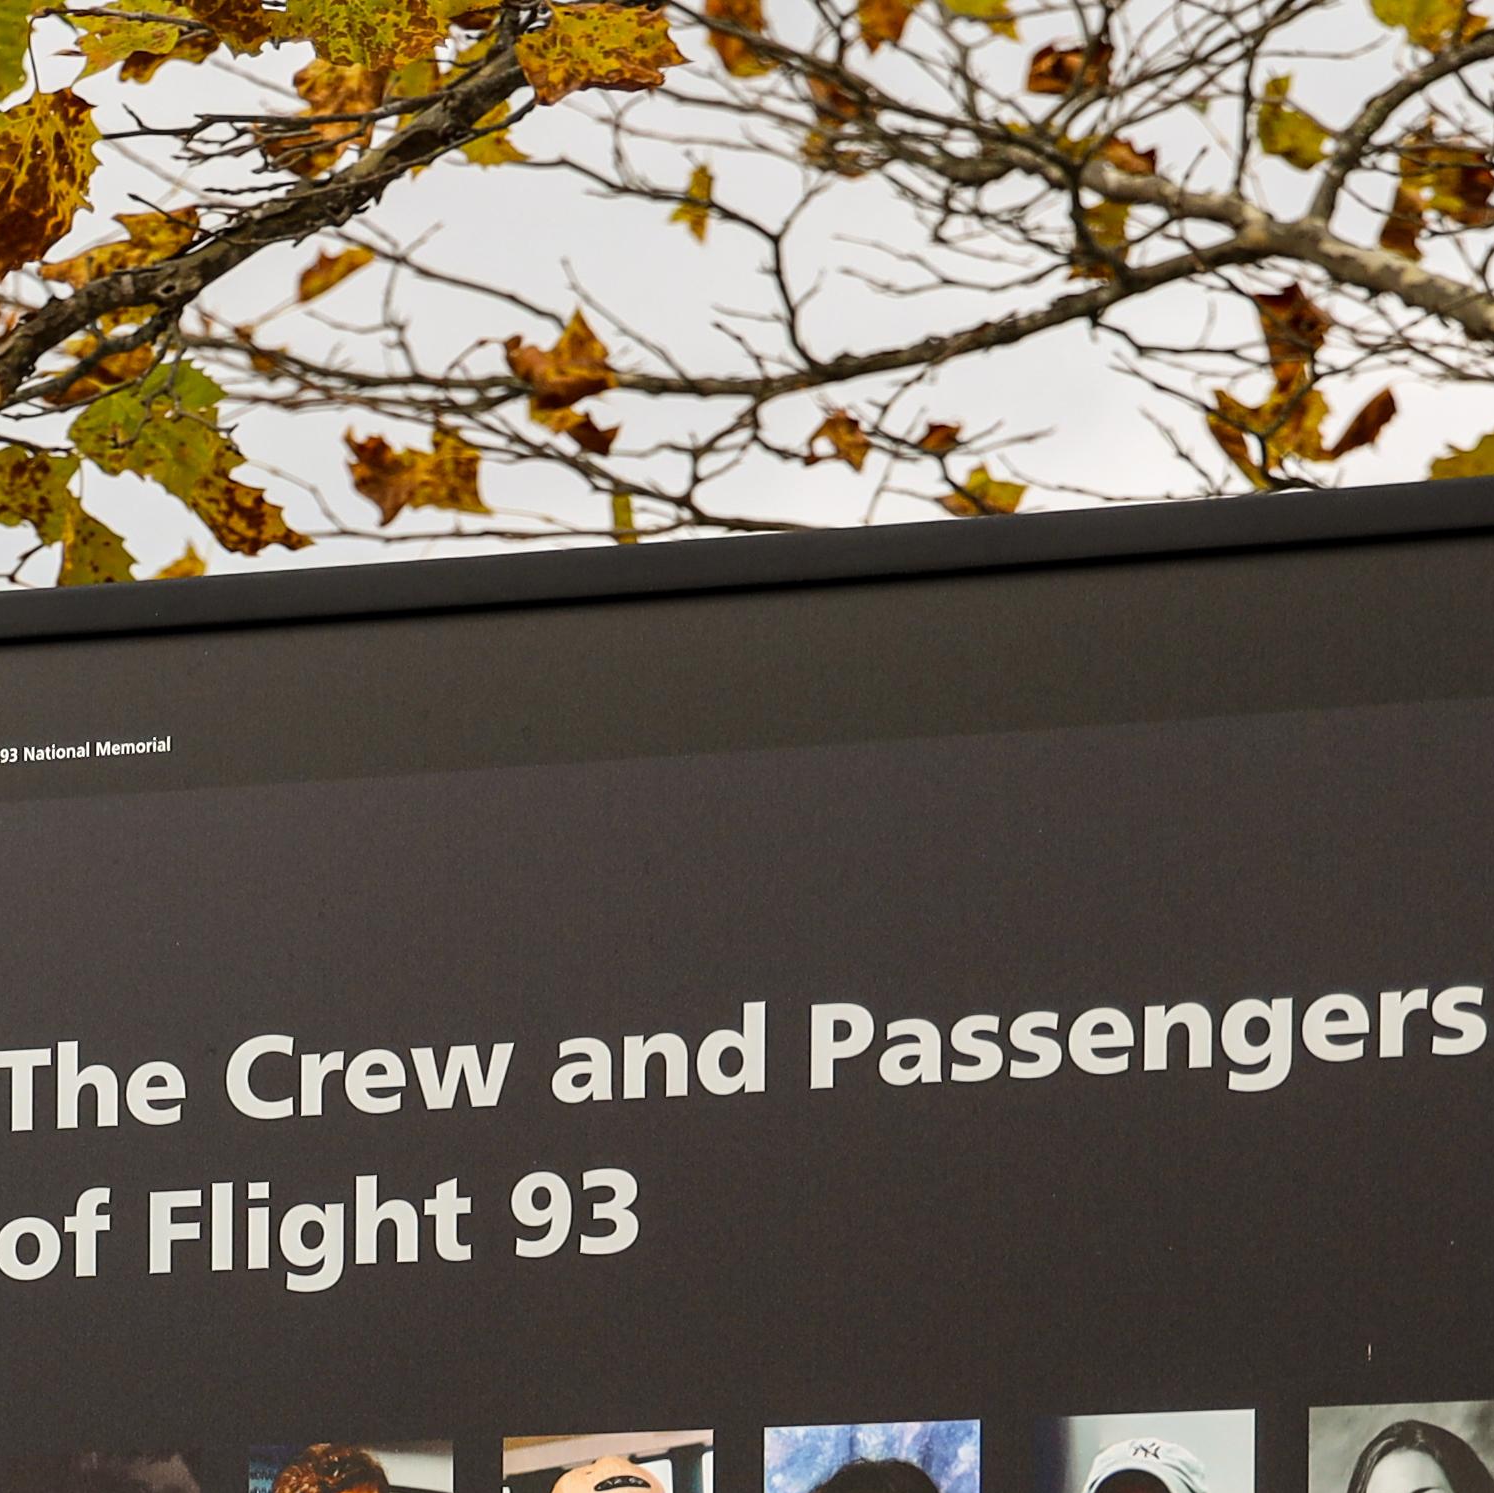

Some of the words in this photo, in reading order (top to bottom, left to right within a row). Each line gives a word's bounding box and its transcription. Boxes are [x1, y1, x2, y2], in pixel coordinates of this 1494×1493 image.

[0, 748, 17, 763] 93
[24, 742, 89, 761] National
[96, 736, 170, 756] Memorial
[226, 1035, 514, 1119] Crew
[552, 1001, 766, 1103] and
[811, 986, 1487, 1091] Passengers
[149, 1175, 471, 1292] Flight
[511, 1168, 638, 1257] 93
